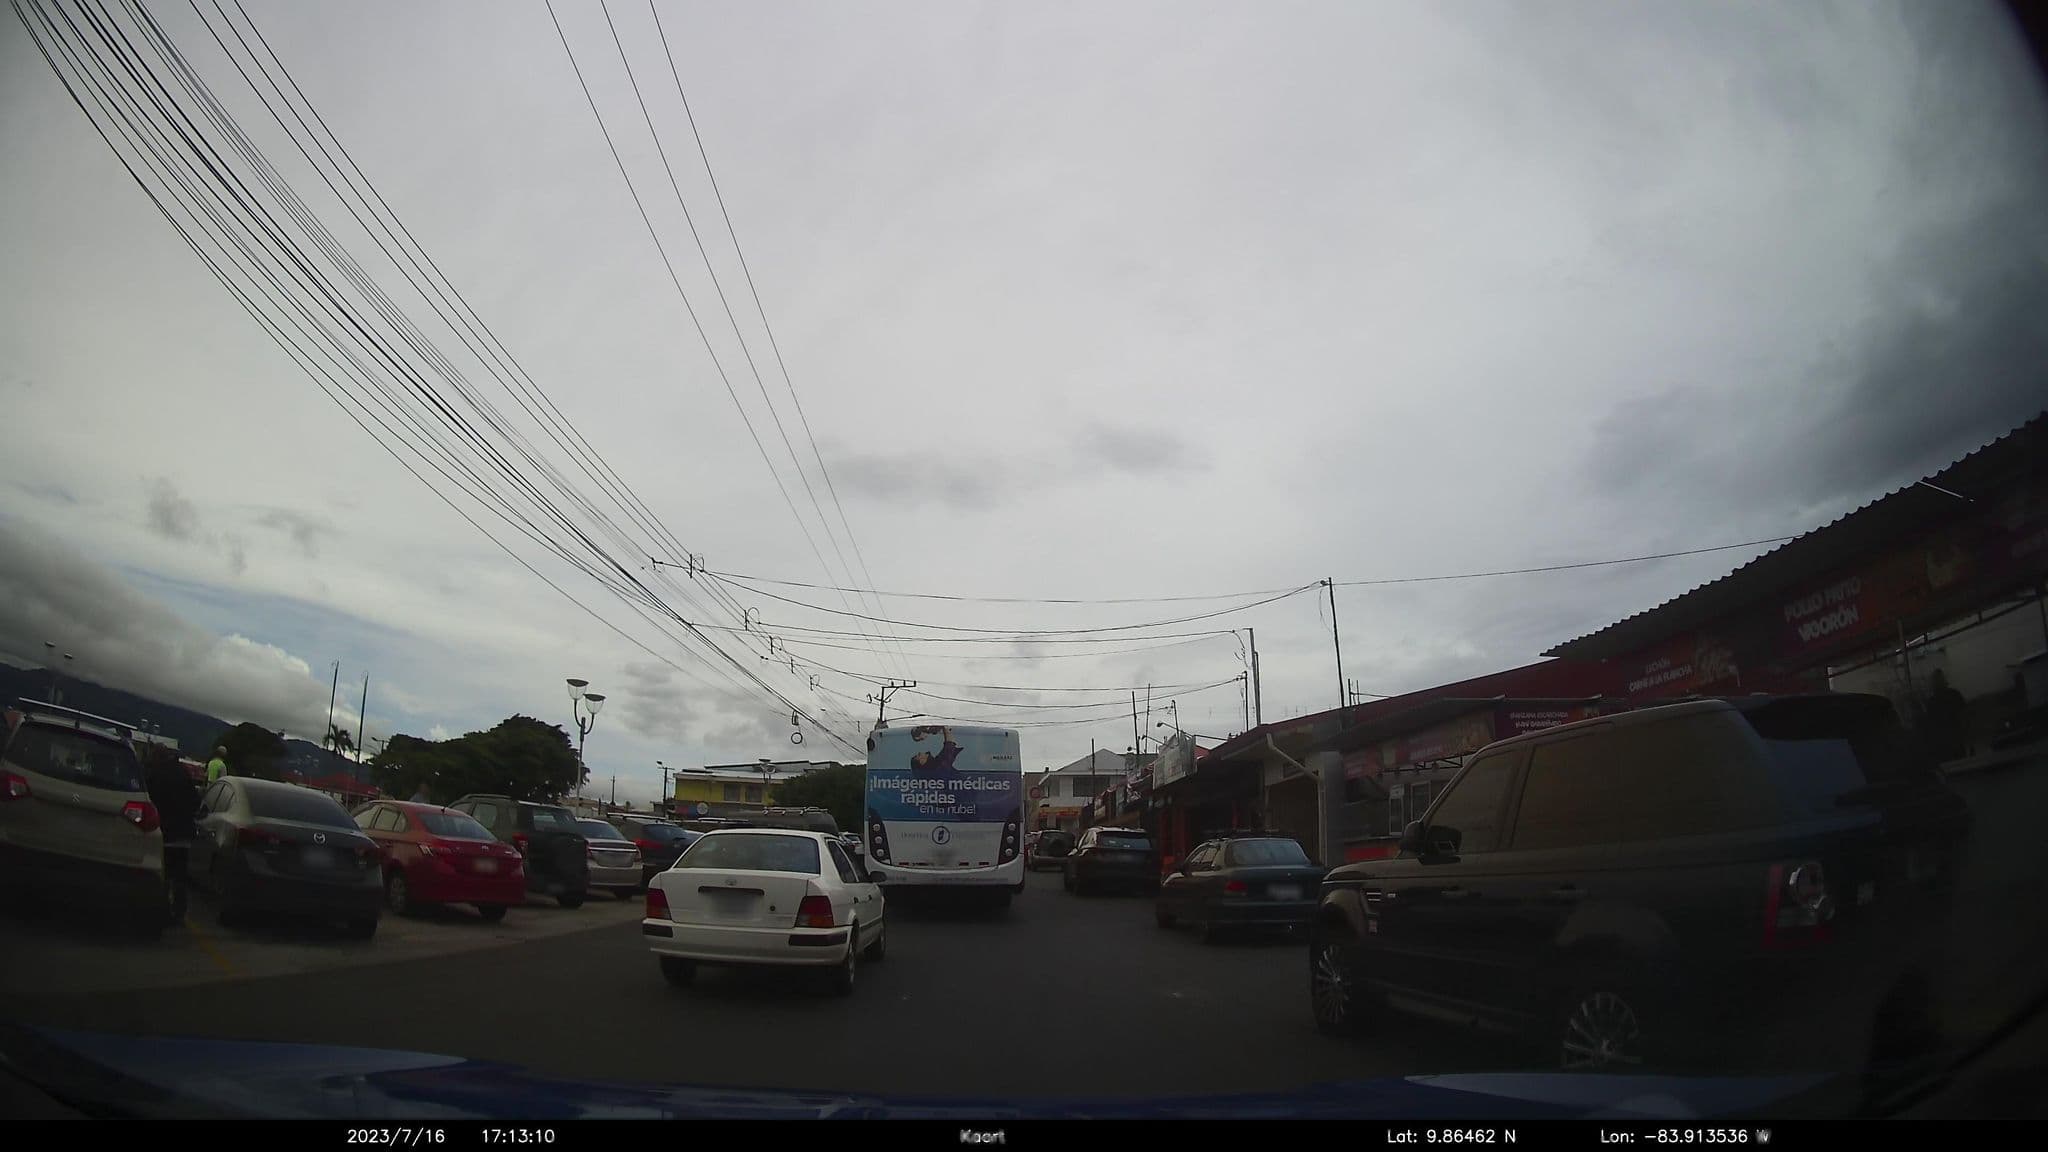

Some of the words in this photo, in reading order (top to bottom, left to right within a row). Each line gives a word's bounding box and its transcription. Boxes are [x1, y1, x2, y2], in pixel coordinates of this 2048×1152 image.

[1784, 593, 1823, 623] POLLO
[869, 775, 944, 792] ¡Imágenes
[948, 776, 1010, 790] médicas
[900, 790, 956, 807] rápidas
[919, 805, 933, 814] en
[936, 804, 945, 814] la
[947, 804, 976, 815] nube!
